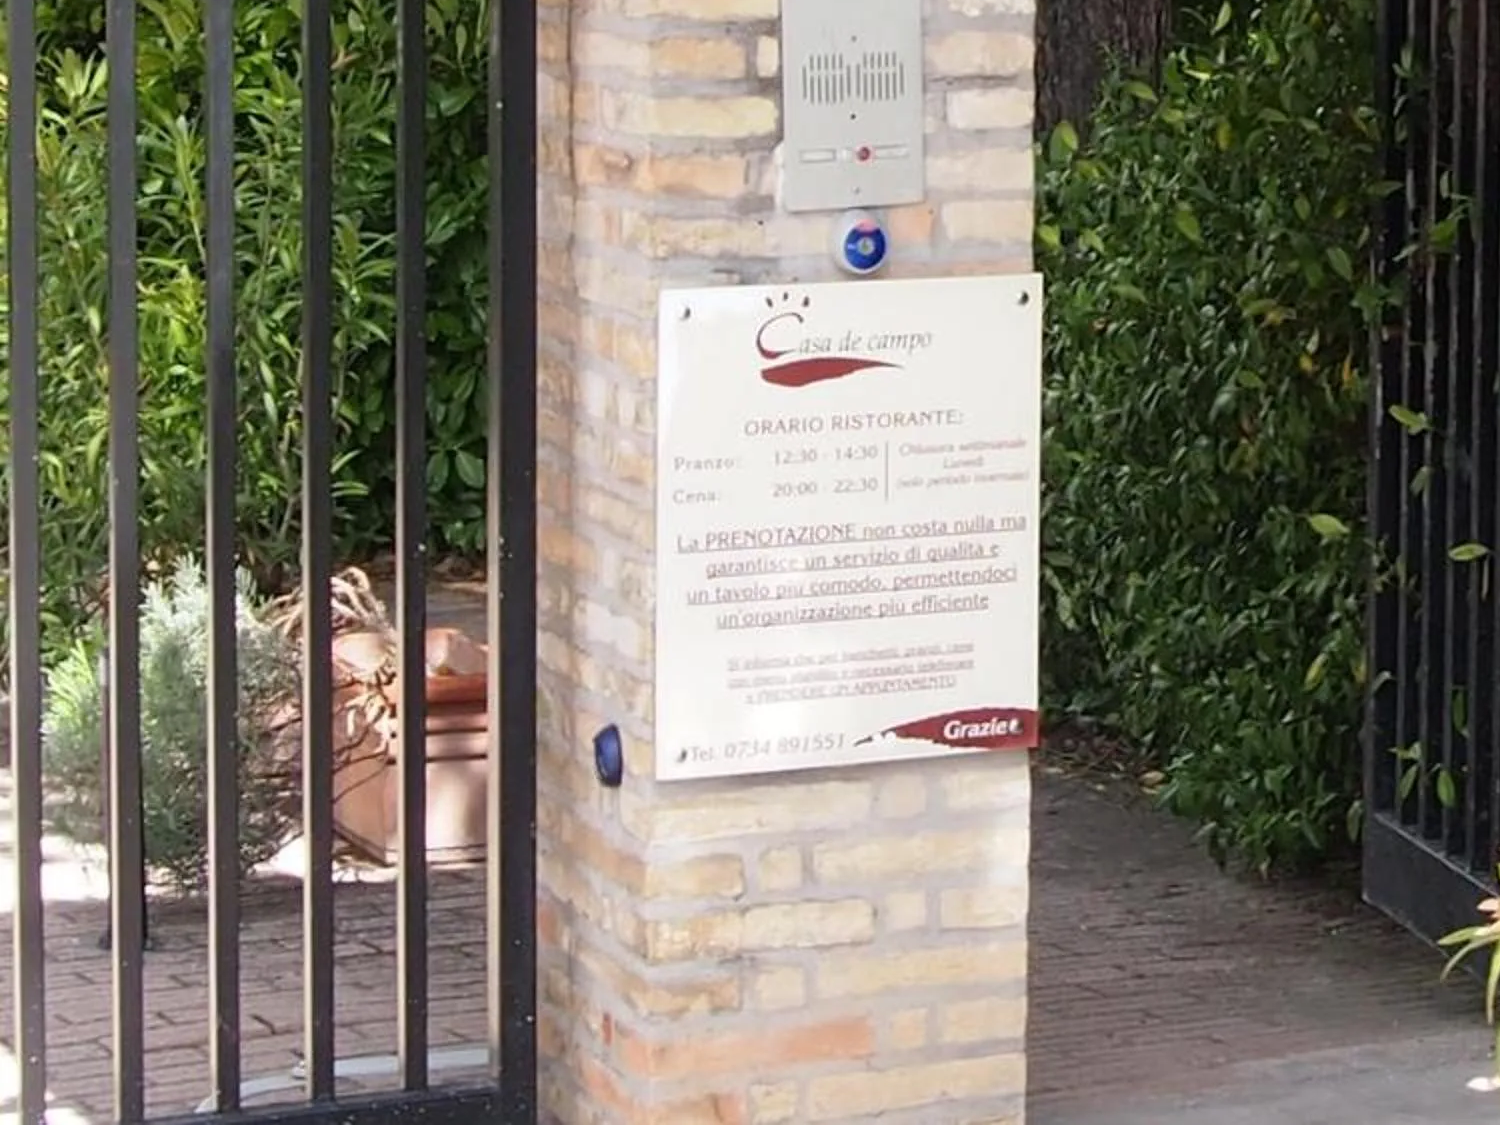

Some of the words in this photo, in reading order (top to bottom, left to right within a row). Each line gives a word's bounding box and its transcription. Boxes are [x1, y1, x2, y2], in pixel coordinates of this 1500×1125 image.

[757, 312, 831, 359] Casa
[843, 330, 862, 352] de
[867, 331, 933, 355] campo
[744, 416, 824, 437] ORARIO
[831, 409, 964, 432] RISTORANTE:
[834, 444, 879, 461] 14:30
[677, 533, 700, 554] La
[706, 523, 856, 551] PRENOTAZIONE
[863, 525, 895, 541] non
[902, 520, 948, 538] costa
[954, 514, 995, 536] nulla
[1001, 515, 1027, 532] ma
[706, 556, 800, 580] garantisce
[805, 555, 826, 571] un
[833, 547, 899, 569] servizio
[905, 545, 920, 564] di
[990, 544, 1000, 557] e
[687, 589, 709, 606] un
[716, 581, 770, 603] tavolo
[894, 563, 1018, 591] permettendoci
[912, 594, 990, 615] efficiente
[724, 738, 771, 759] 0734
[777, 732, 845, 755] 891551
